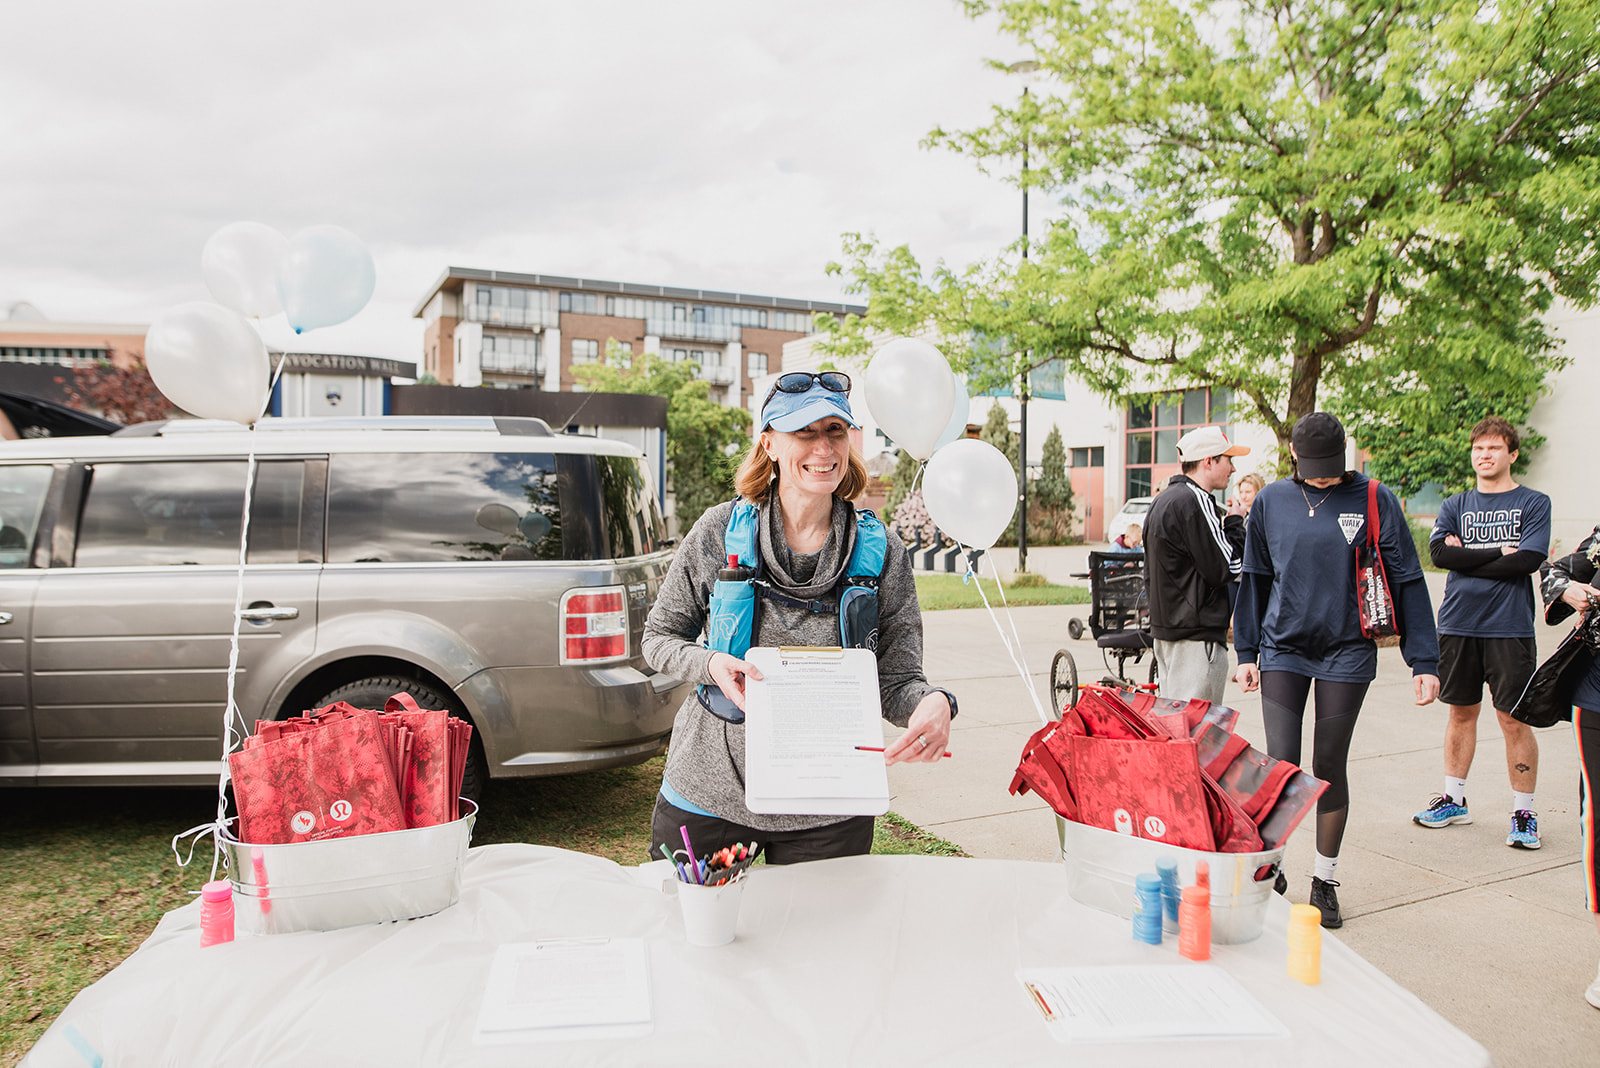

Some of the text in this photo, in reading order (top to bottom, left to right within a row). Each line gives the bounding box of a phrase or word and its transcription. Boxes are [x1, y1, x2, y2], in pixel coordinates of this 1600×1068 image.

[270, 354, 366, 370] ONVOCATION
[1341, 519, 1360, 527] WALK
[1461, 509, 1522, 543] CURE
[1365, 567, 1378, 627] Team Canada
[1376, 575, 1387, 619] lululemon
